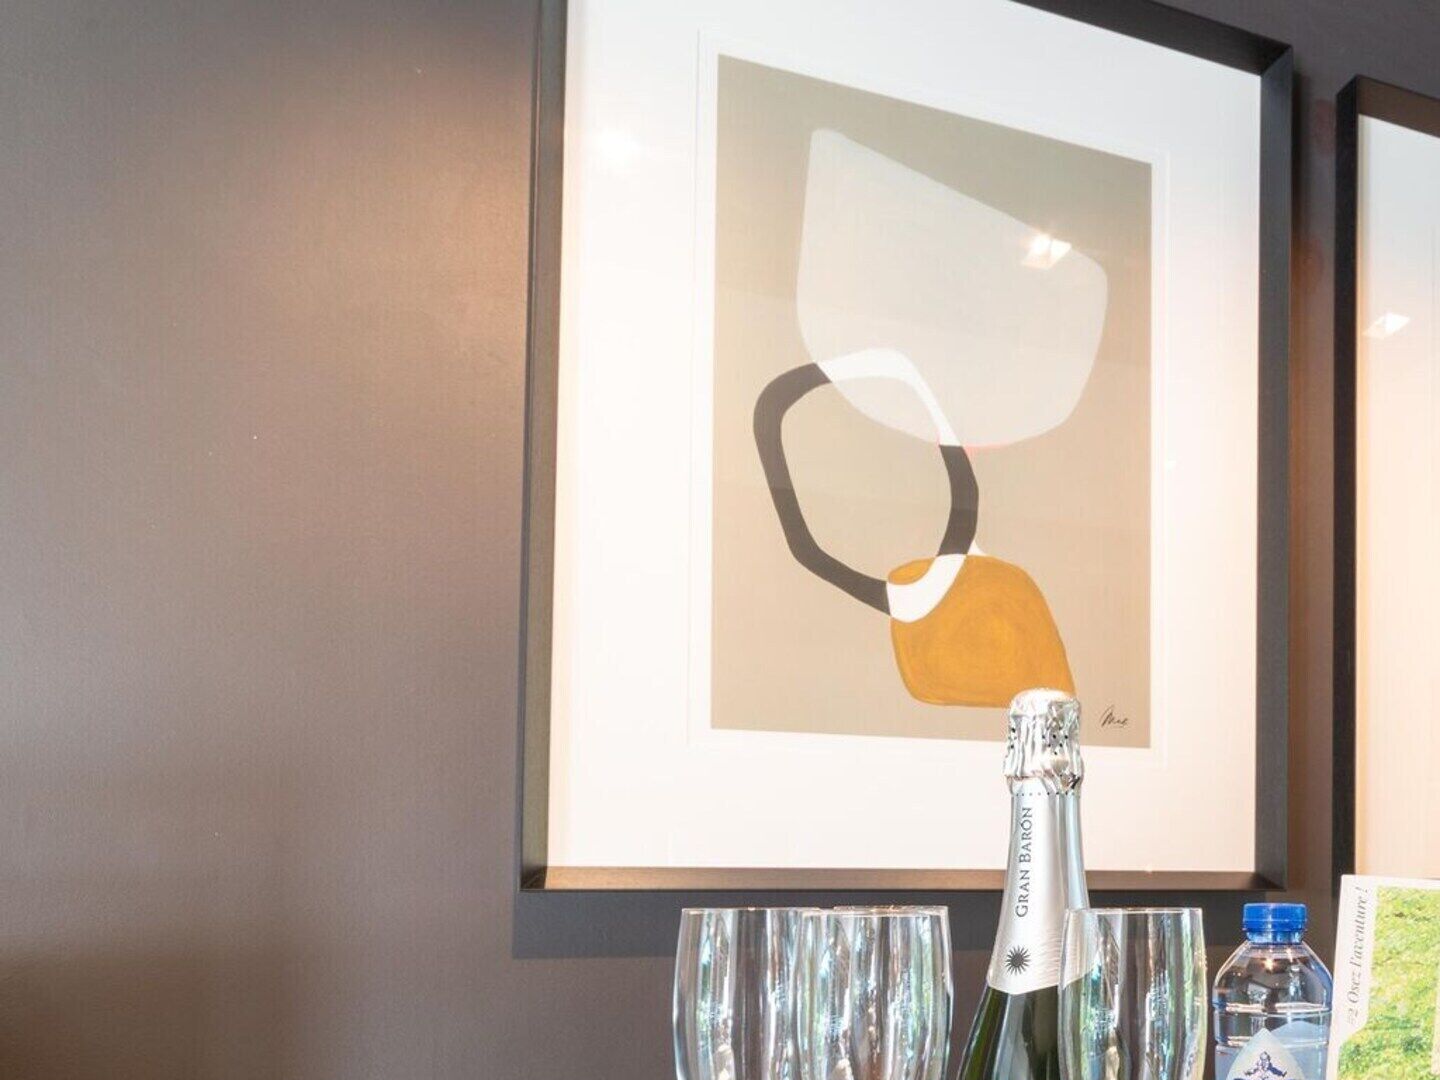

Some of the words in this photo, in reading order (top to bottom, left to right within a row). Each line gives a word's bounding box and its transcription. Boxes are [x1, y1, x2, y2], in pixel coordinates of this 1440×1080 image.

[1018, 807, 1033, 863] BARÓN
[1014, 869, 1031, 918] GRAN
[1349, 895, 1367, 967] l'aventure
[1347, 970, 1361, 1004] Osez
